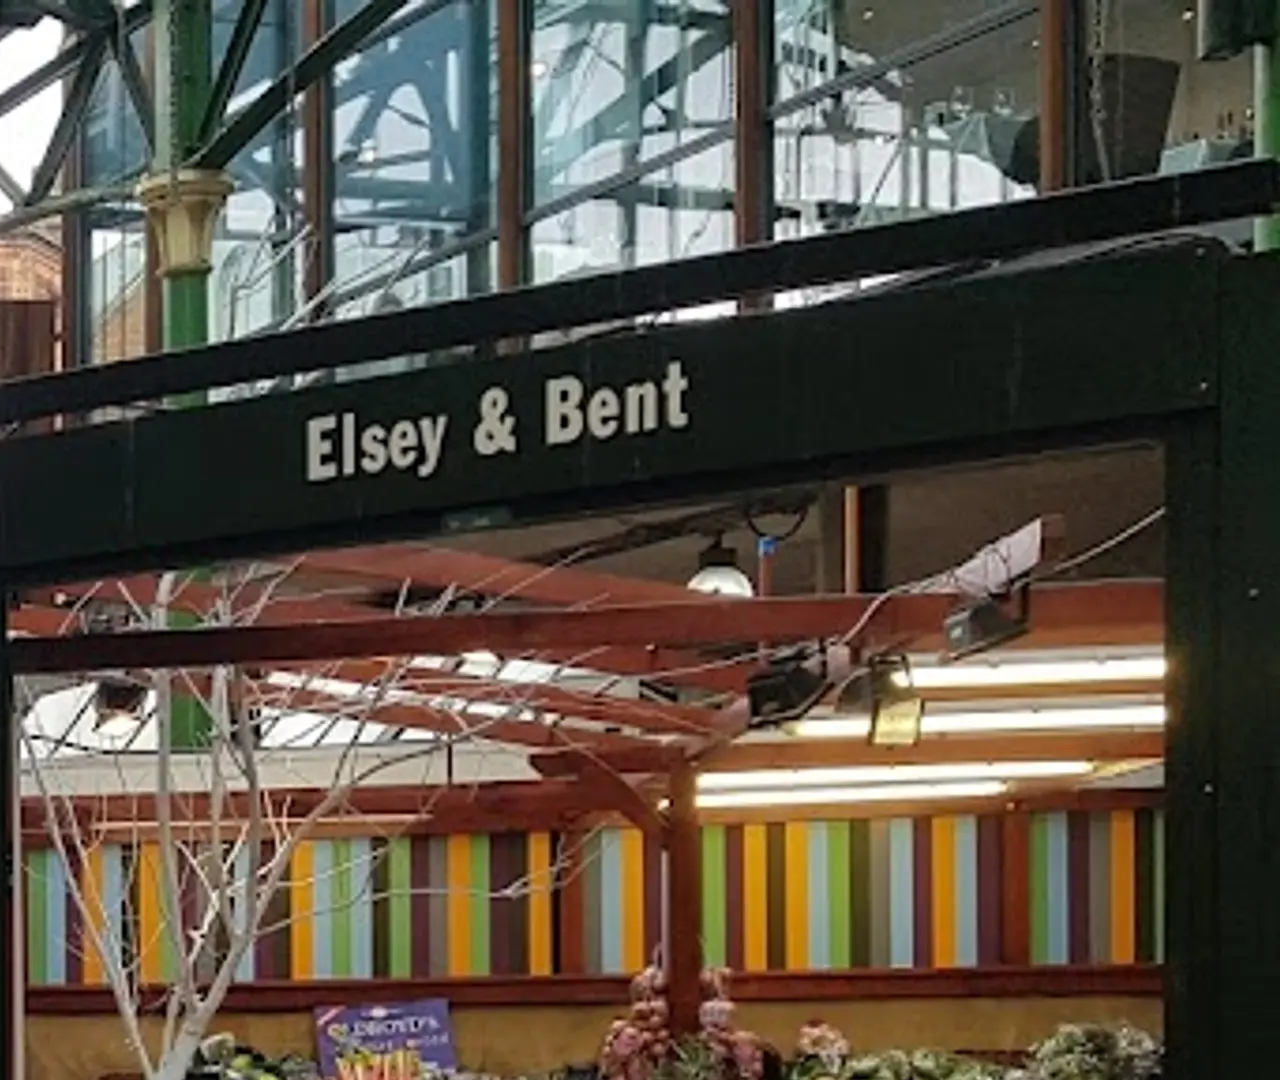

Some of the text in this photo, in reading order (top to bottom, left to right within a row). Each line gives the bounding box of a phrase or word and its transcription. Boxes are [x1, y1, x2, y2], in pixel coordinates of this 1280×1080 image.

[306, 360, 689, 482] Elsey & Bent
